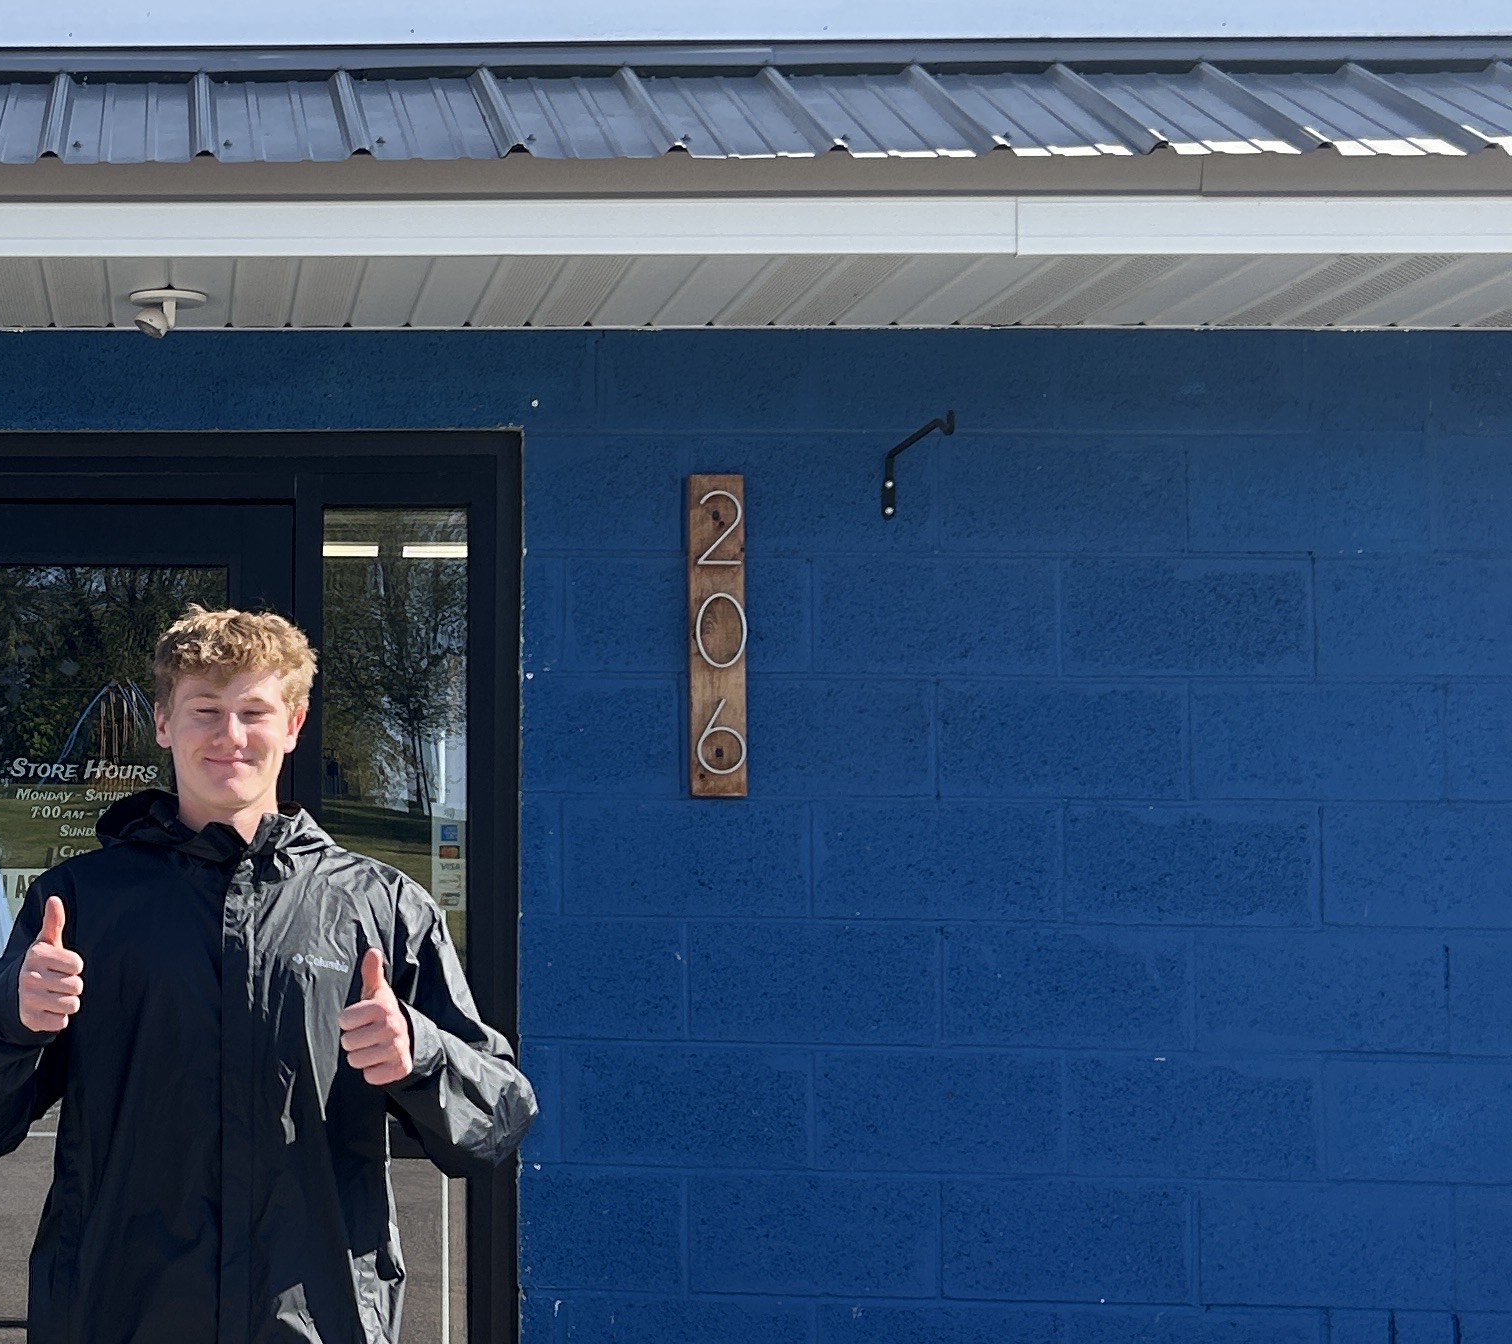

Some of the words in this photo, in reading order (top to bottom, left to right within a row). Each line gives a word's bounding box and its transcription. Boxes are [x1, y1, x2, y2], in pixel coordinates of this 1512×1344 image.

[695, 490, 748, 775] 206
[10, 757, 79, 781] STORE
[83, 759, 159, 783] HOURS
[15, 788, 74, 804] MONDAY
[30, 805, 61, 819] 7:00
[304, 953, 349, 974] Columbia
